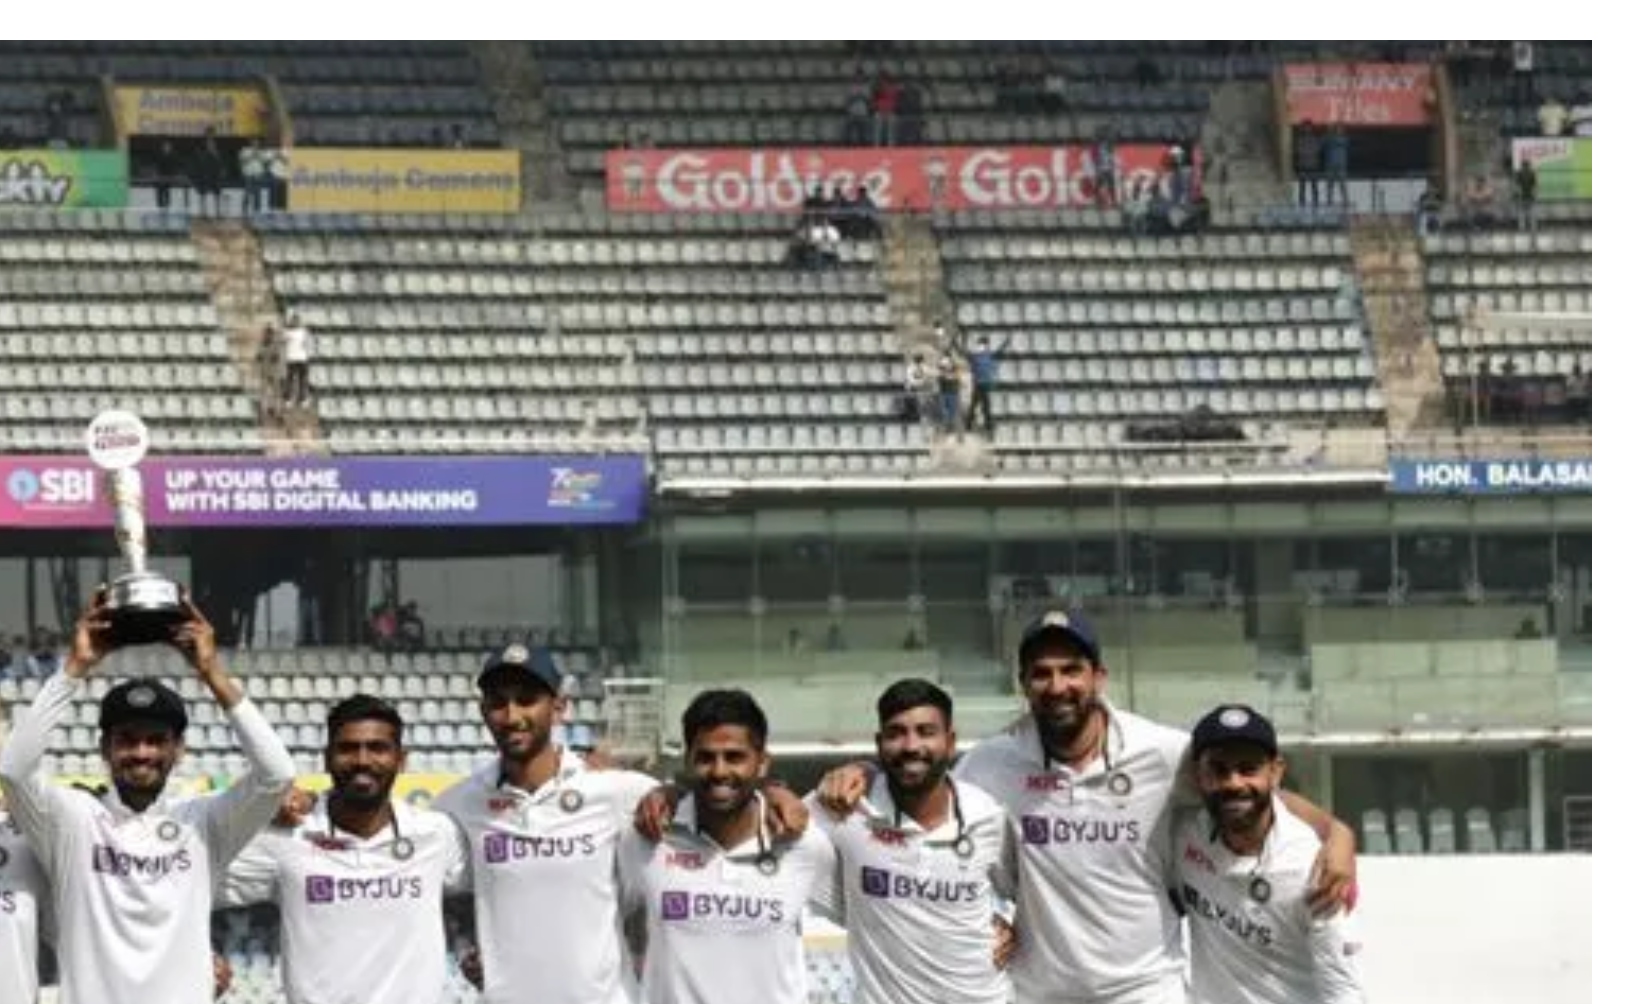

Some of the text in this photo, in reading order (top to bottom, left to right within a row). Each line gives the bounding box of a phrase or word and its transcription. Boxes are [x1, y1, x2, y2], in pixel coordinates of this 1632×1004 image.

[40, 469, 94, 501] SBI
[166, 469, 339, 489] UP YOUR GAME
[1417, 463, 1592, 486] HON. BALASA
[166, 491, 229, 511] WITH
[273, 491, 365, 511] DIGITAL
[370, 490, 478, 510] BANKING
[1053, 818, 1142, 844] BYJU'S
[512, 833, 597, 861] BYJU'S
[338, 876, 423, 900] BYJU'S
[893, 873, 981, 902] BYJU'S
[693, 893, 785, 923] BYJU'S
